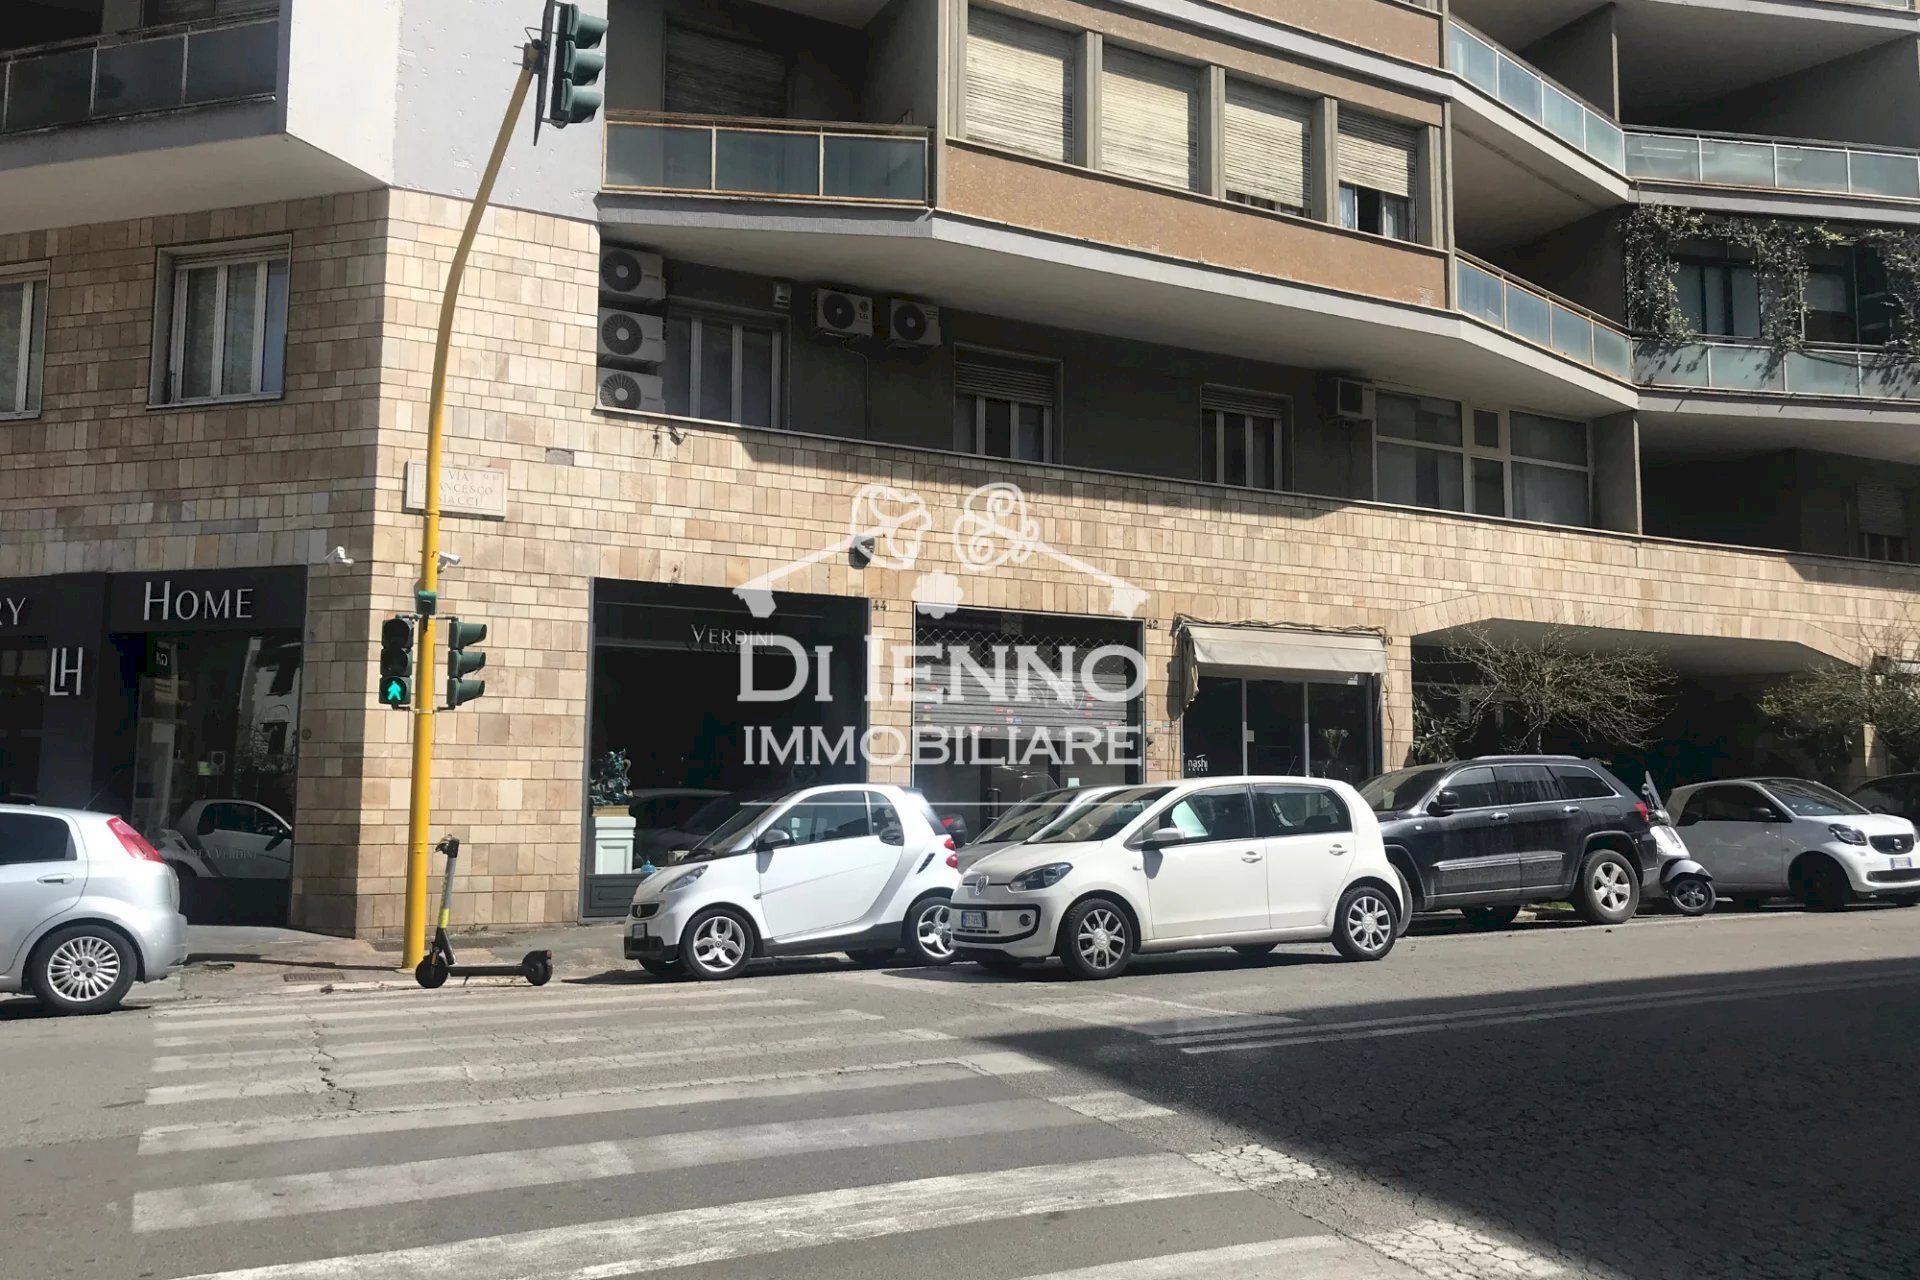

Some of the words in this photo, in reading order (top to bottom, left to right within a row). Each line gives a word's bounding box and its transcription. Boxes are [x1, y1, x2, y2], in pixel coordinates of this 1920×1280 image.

[448, 470, 469, 481] VIA
[421, 480, 494, 496] ANCESCO
[144, 580, 254, 621] HOME
[873, 599, 887, 611] 44
[0, 597, 26, 625] Y
[1146, 619, 1158, 629] 42
[691, 624, 774, 647] VERDINI
[49, 647, 83, 696] LH
